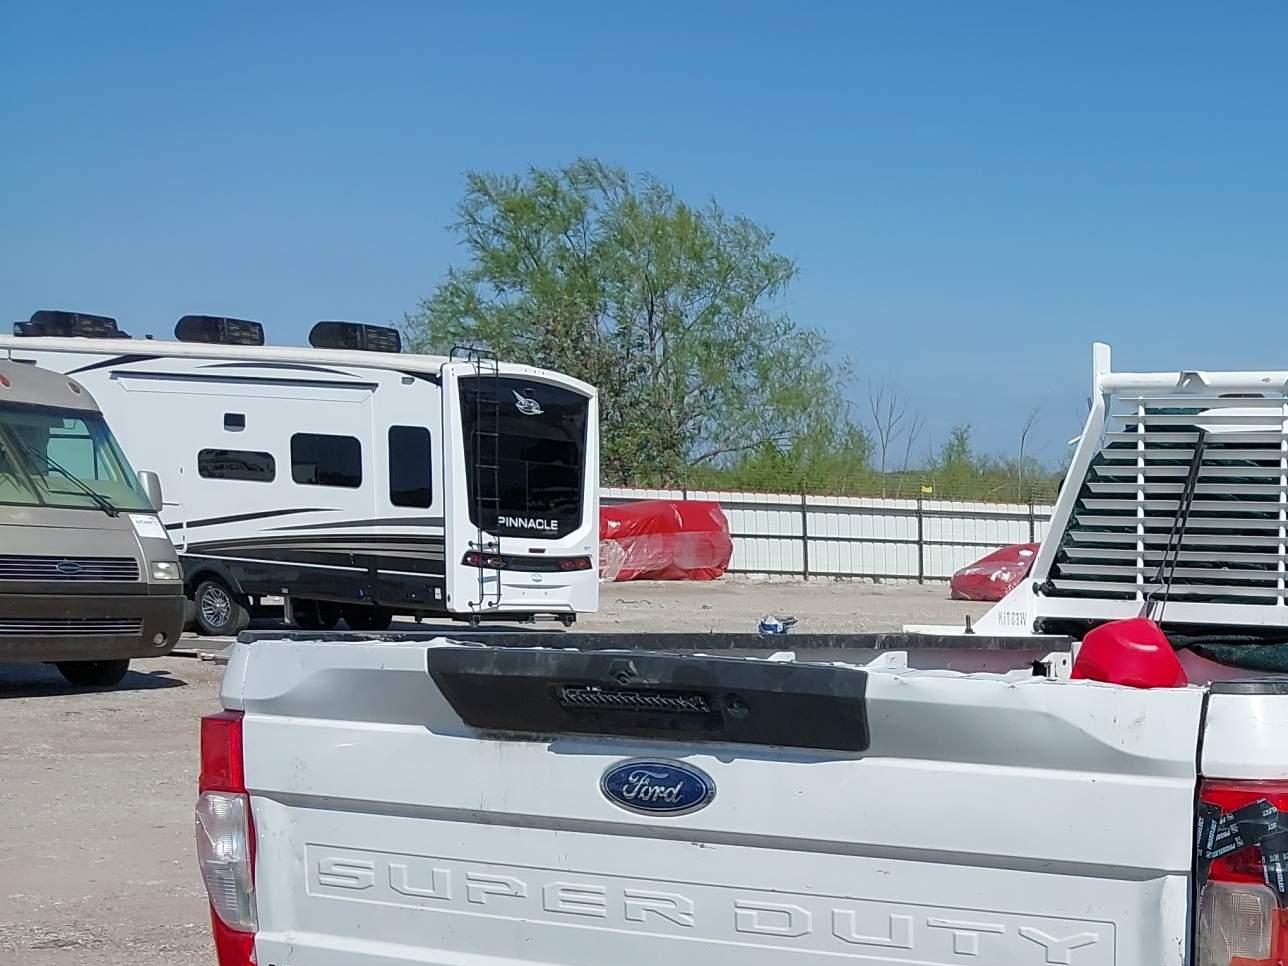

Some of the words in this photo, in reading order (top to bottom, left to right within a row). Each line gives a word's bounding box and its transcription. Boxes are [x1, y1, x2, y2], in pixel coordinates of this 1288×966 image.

[498, 516, 558, 530] PINNACLE
[622, 769, 685, 803] Ford
[1207, 819, 1217, 850] PROSELECT
[1275, 862, 1285, 893] PROSELECT
[318, 857, 696, 928] SUPER
[735, 899, 1100, 965] DUTY
